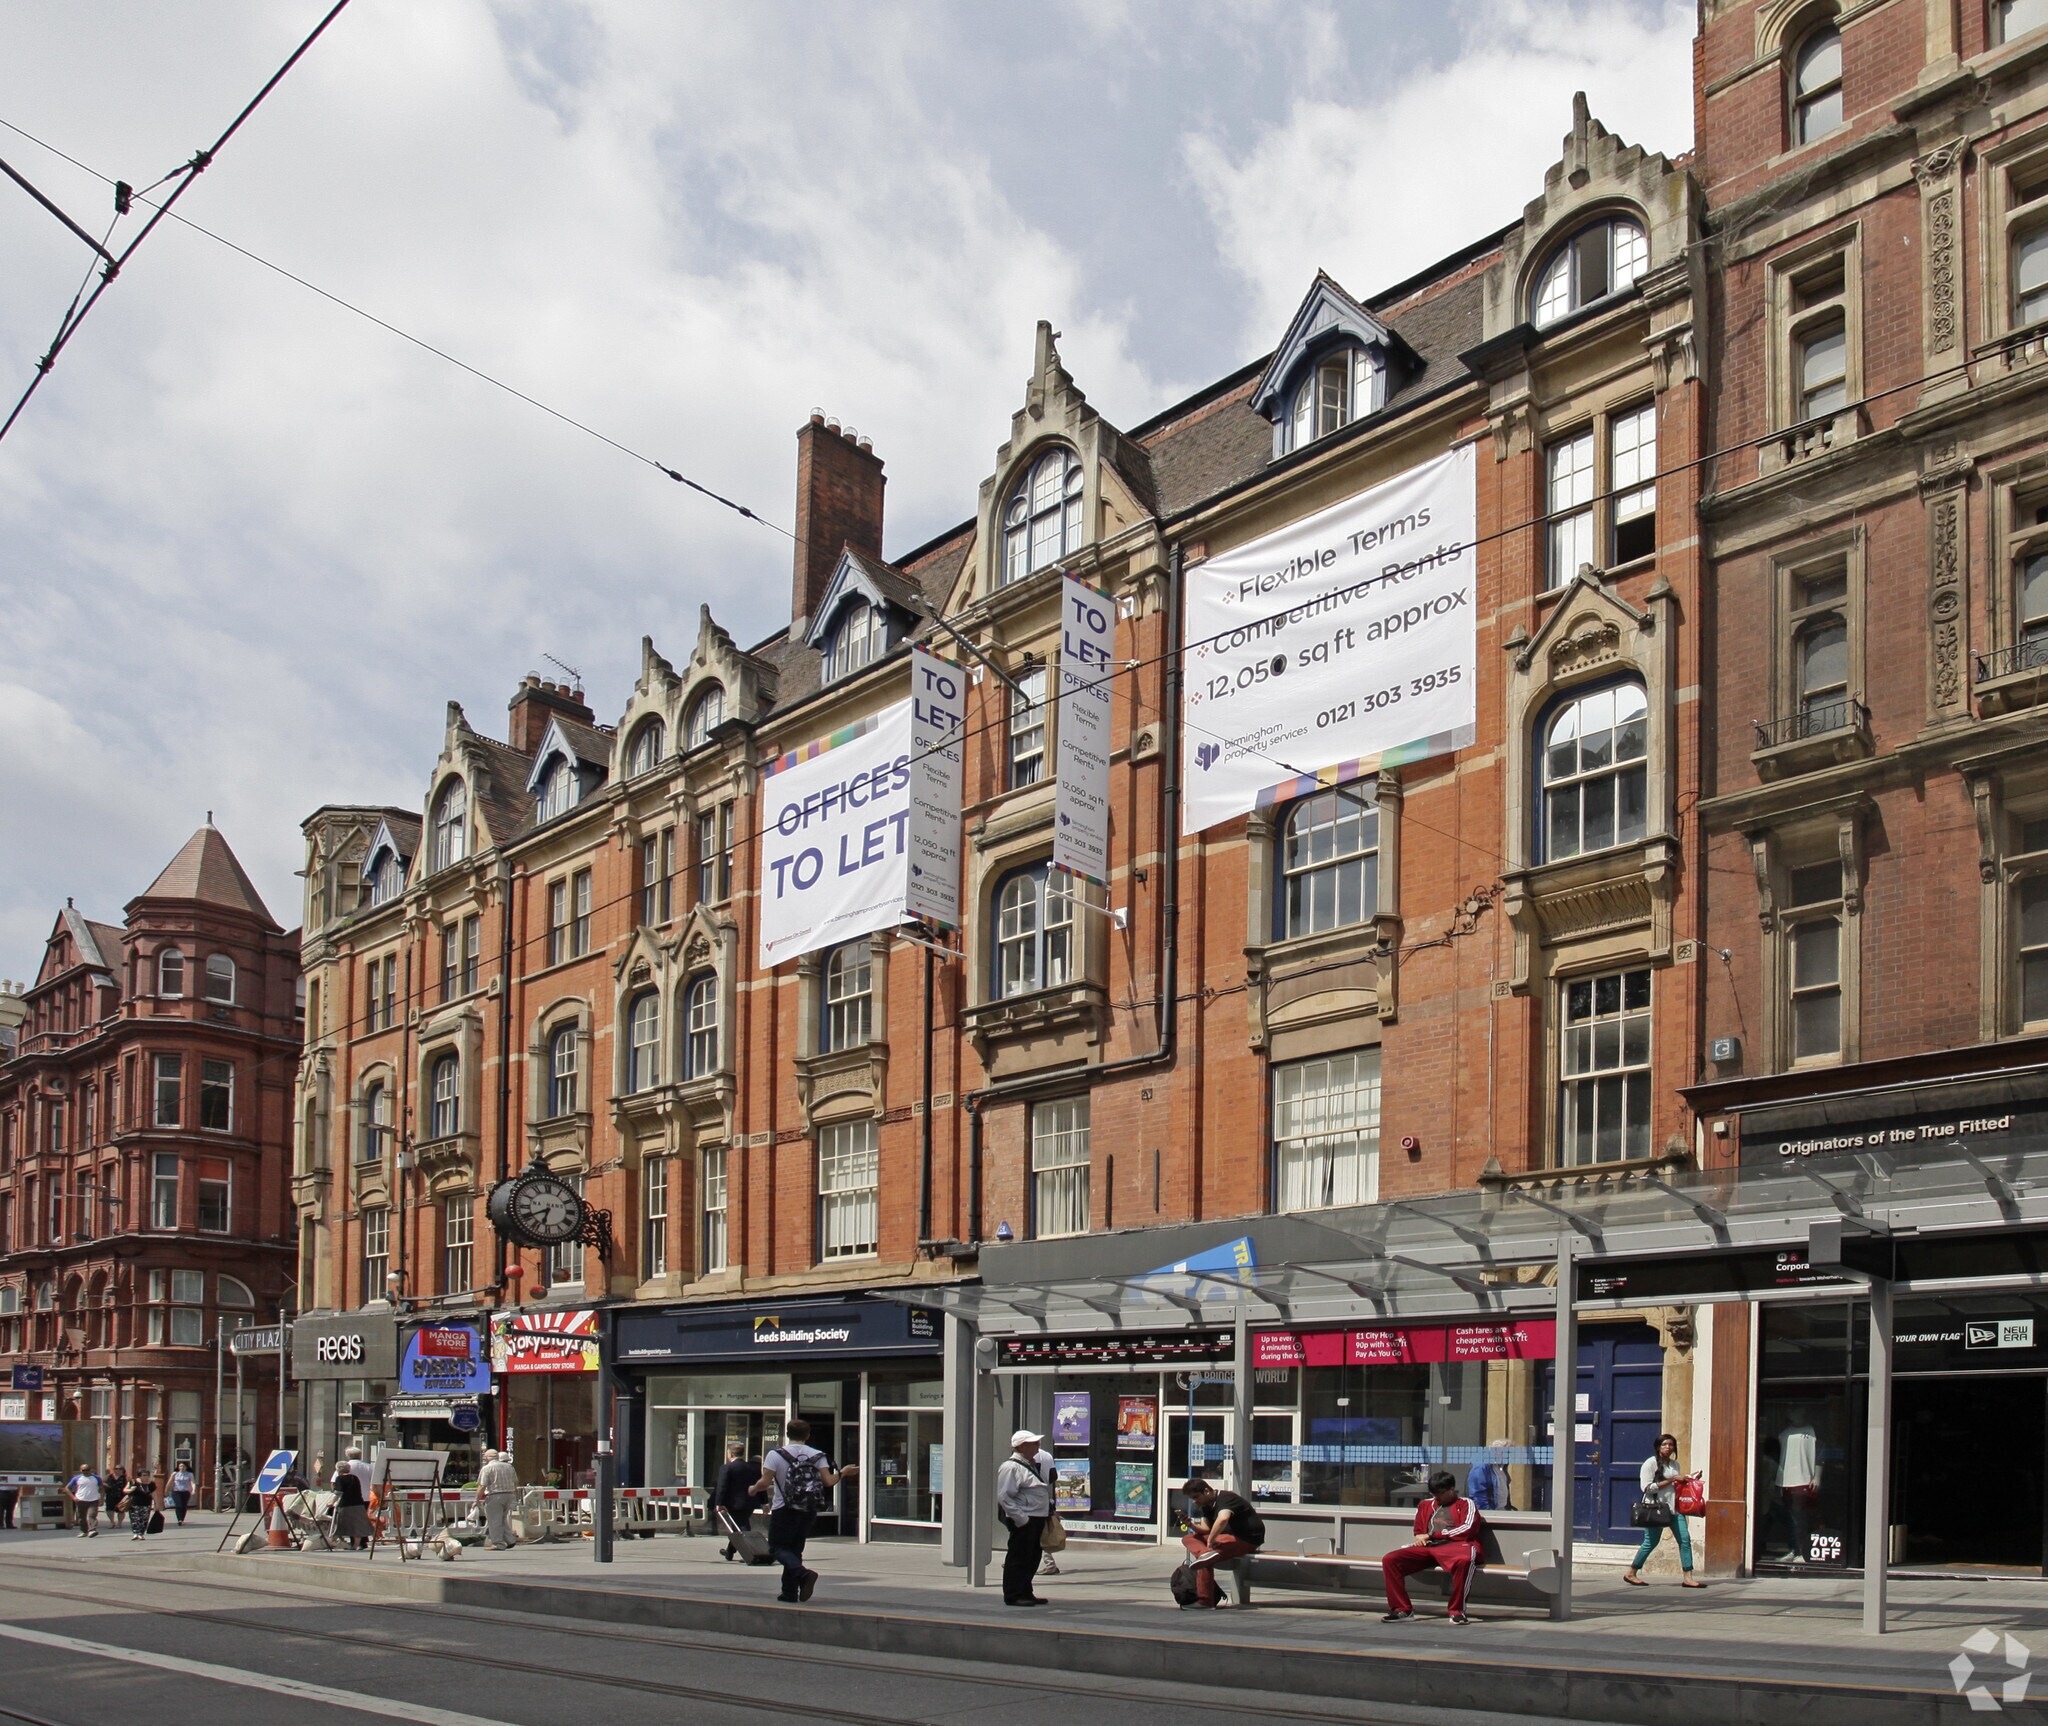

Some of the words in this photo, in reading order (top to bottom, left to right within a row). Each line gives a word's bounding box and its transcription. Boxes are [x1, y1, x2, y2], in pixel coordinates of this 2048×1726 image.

[1240, 548, 1336, 602] Flexible
[1347, 507, 1431, 556] Terms
[1213, 581, 1370, 654] Competitive
[1381, 541, 1462, 590] Rents
[1071, 596, 1107, 634] TO
[1064, 631, 1111, 673] LET
[1206, 654, 1288, 701] 12,050
[1299, 641, 1329, 667] sq
[1334, 628, 1356, 654] ft
[1366, 587, 1468, 641] approx
[920, 666, 957, 700] TO
[1064, 673, 1110, 703] OFFICES
[1316, 702, 1356, 729] 0121
[1363, 686, 1402, 713] 303
[1410, 664, 1462, 697] 3935
[914, 697, 962, 735] LET
[1072, 702, 1100, 722] Flexible
[1074, 714, 1097, 730] Terms
[1224, 723, 1283, 750] birmingham
[1224, 739, 1268, 764] property
[1269, 725, 1308, 746] services
[1062, 739, 1107, 767] Competitive
[1073, 754, 1095, 771] Rents
[922, 763, 951, 780] Flexible
[925, 773, 947, 788] Terms
[1061, 780, 1087, 797] 12,050
[777, 754, 911, 836] OFFICES
[1069, 795, 1095, 811] approx
[913, 797, 958, 821] Competitive
[924, 810, 946, 825] Rents
[838, 808, 910, 877] LET
[913, 835, 938, 850] 12,050
[921, 848, 948, 863] approx
[770, 847, 824, 899] TO
[1778, 1134, 1864, 1155] Originators
[1868, 1130, 1885, 1145] of
[1889, 1128, 1916, 1142] the
[1918, 1123, 1955, 1138] True
[1959, 1115, 2010, 1133] Fitted
[911, 1323, 934, 1331] Building
[912, 1329, 932, 1337] Society
[2003, 1325, 2028, 1334] NEW
[234, 1332, 255, 1349] CITY
[256, 1331, 281, 1348] PLAZ
[429, 1331, 467, 1340] MANGA
[436, 1339, 467, 1347] STORE
[754, 1331, 779, 1343] Leeds
[779, 1330, 814, 1344] Building
[814, 1328, 850, 1342] Society
[1355, 1341, 1369, 1349] 90p
[1386, 1336, 1407, 1347] swift
[1356, 1332, 1364, 1340] £1
[1365, 1332, 1379, 1340] City
[1380, 1331, 1394, 1339] Hop
[1456, 1337, 1485, 1345] cheaper
[1504, 1330, 1528, 1342] swift
[1895, 1335, 1917, 1343] YOUR
[1918, 1334, 1938, 1342] OWN
[1940, 1332, 1961, 1341] FLAG
[2003, 1333, 2028, 1342] ERA
[1355, 1350, 1367, 1359] Pay
[1455, 1347, 1468, 1355] Pay
[413, 1358, 477, 1378] ROBERTS
[1256, 1370, 1289, 1383] WORLD
[1094, 1523, 1146, 1532] statravel.com
[1811, 1536, 1841, 1547] 70%
[1810, 1547, 1841, 1559] OFF
